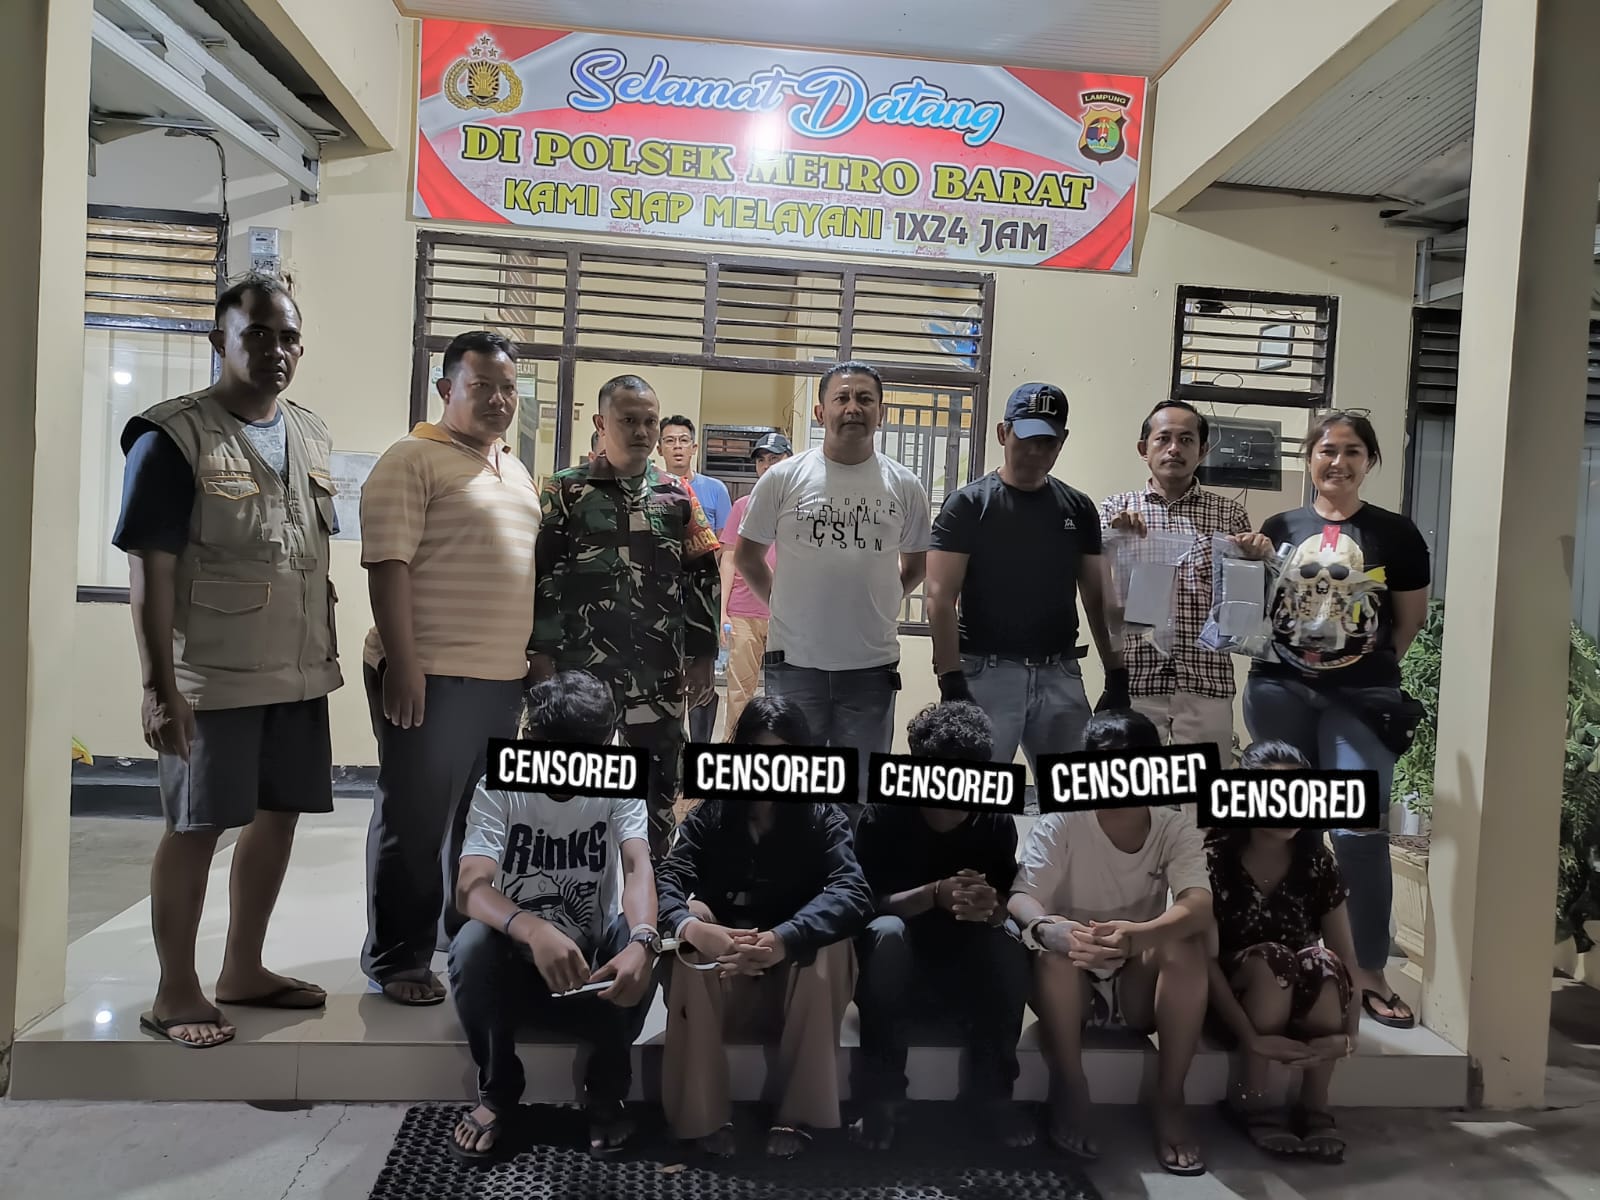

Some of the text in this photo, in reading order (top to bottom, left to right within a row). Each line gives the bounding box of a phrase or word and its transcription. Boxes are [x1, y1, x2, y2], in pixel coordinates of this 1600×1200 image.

[567, 48, 1004, 146] Selamat Datang
[1084, 94, 1127, 104] LAMPUNG
[462, 125, 1093, 210] DI POLSEK METRO BARAT
[504, 179, 1049, 253] KAMI SIAP MELAYANI 1X24 JAM
[796, 509, 881, 525] CARDINAL
[812, 519, 865, 541] CSL
